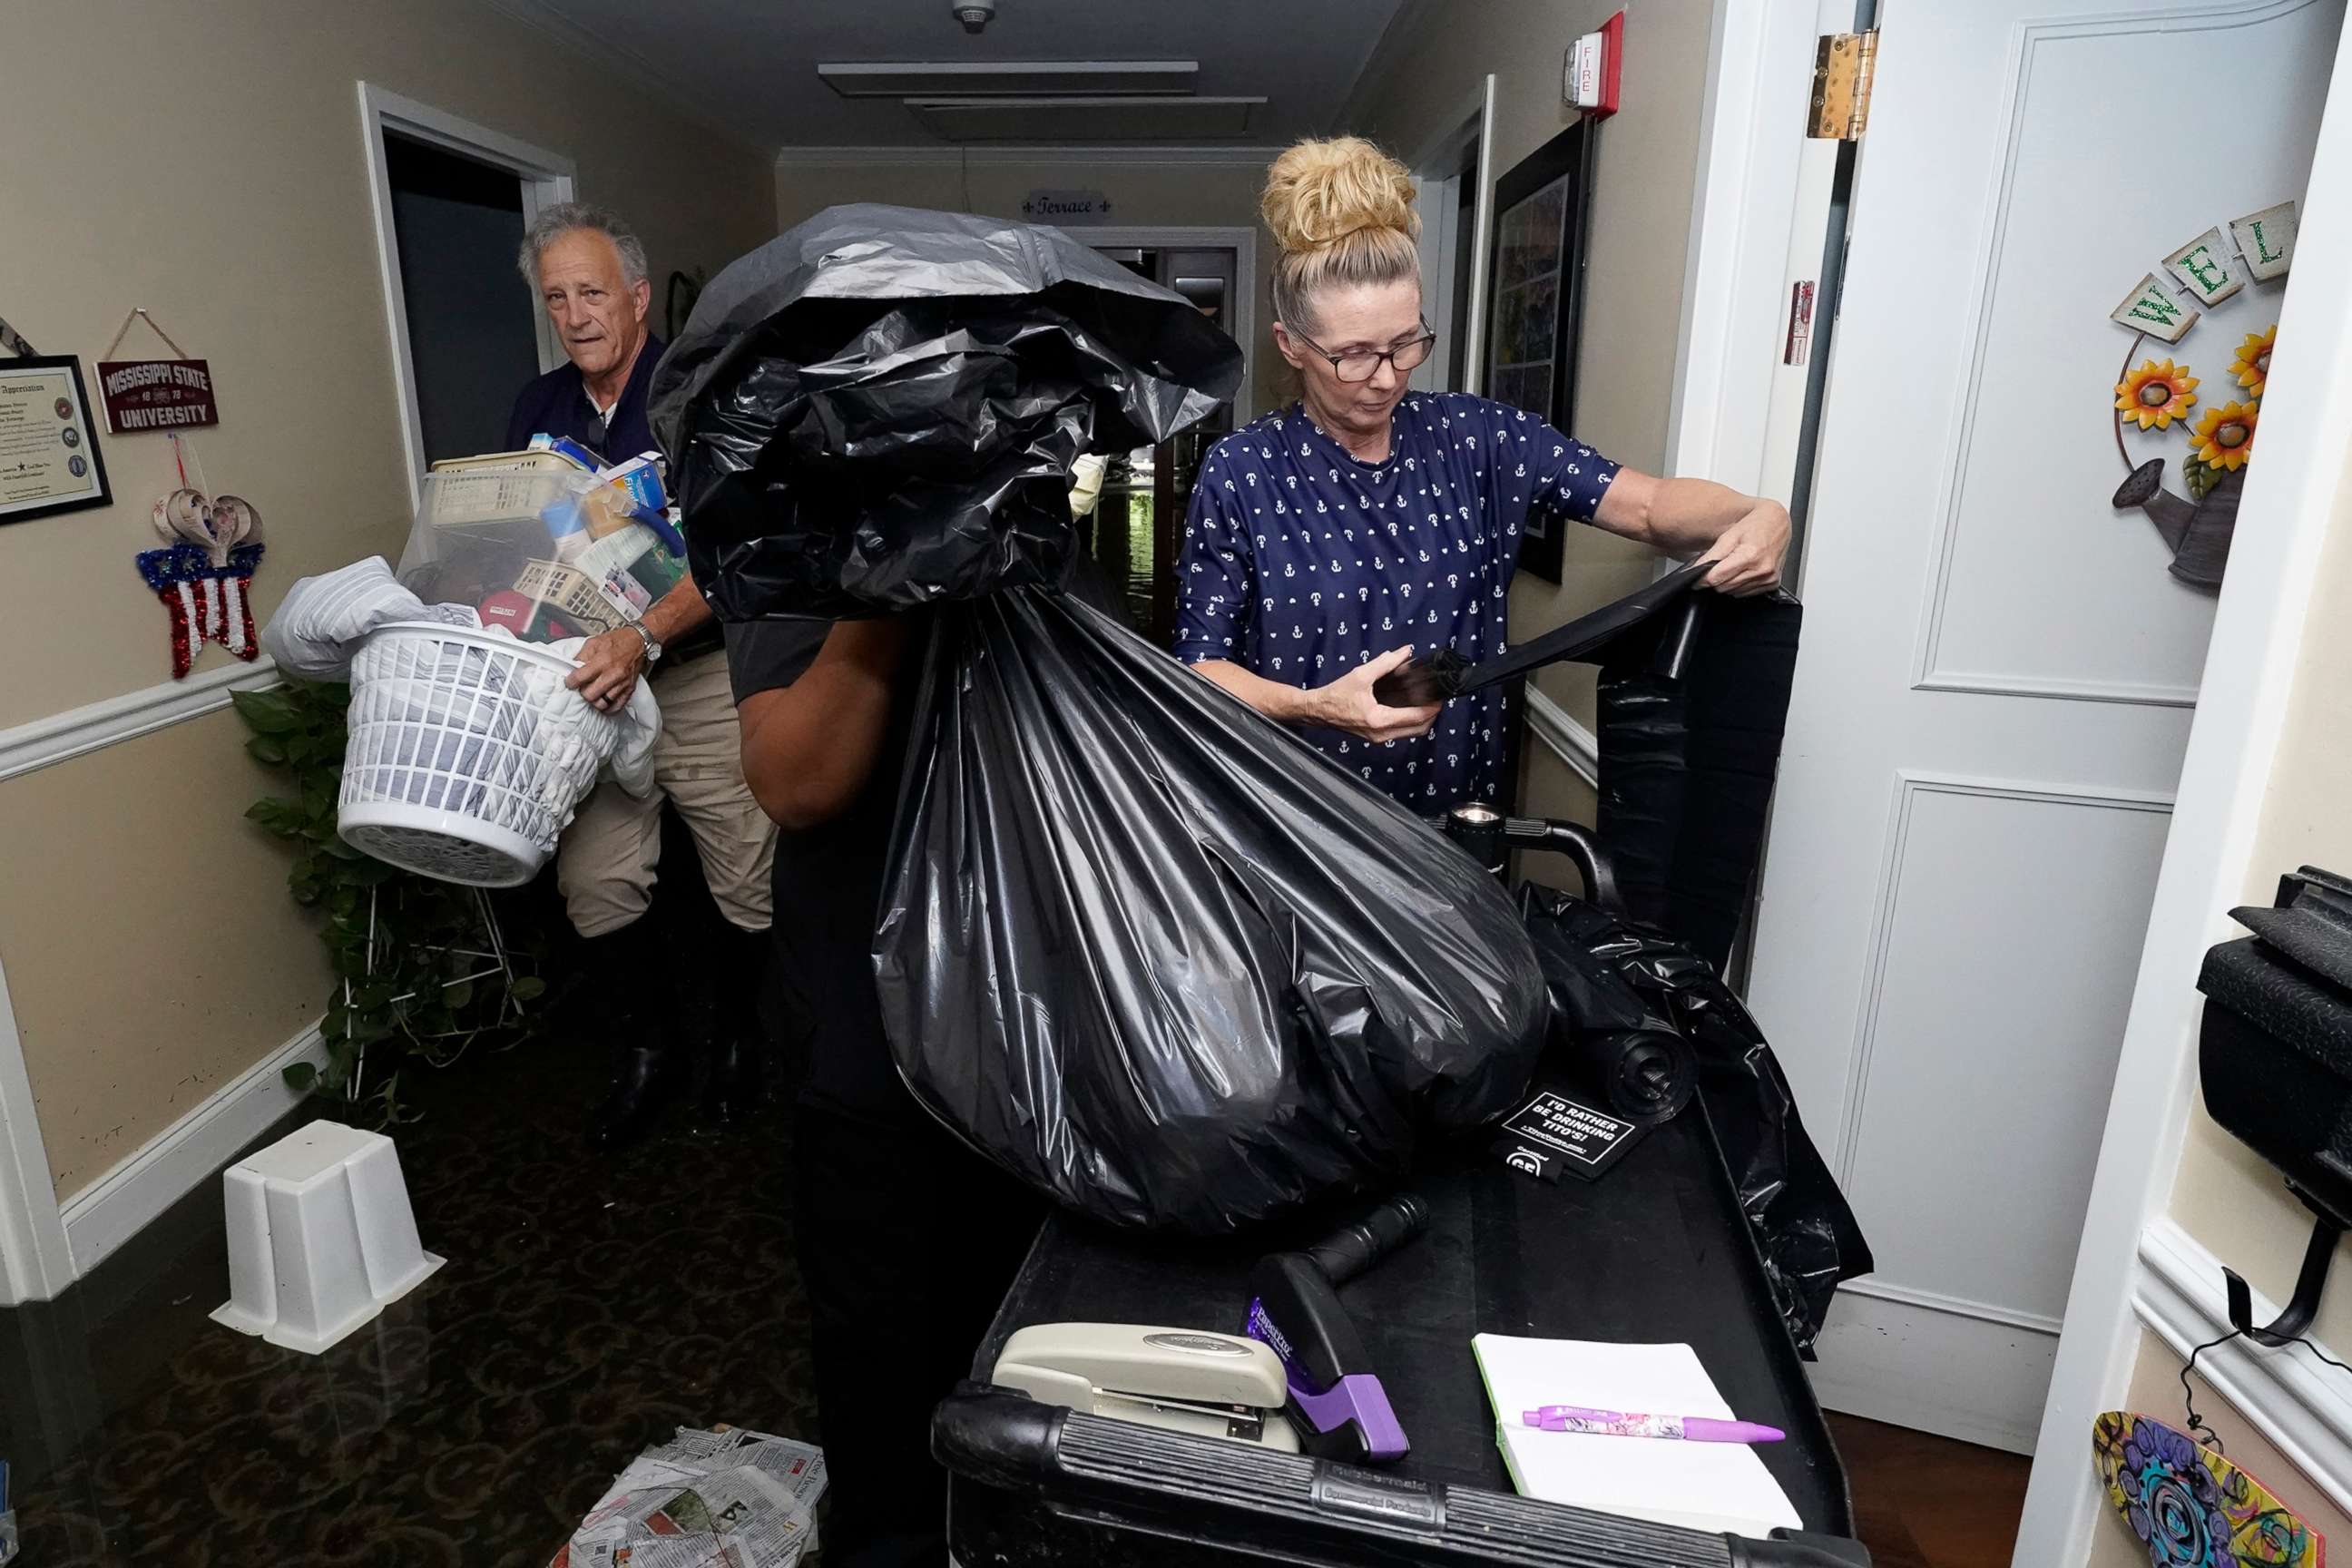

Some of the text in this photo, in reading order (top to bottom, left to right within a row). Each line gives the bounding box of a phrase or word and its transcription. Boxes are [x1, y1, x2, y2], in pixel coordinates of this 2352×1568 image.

[1582, 46, 1592, 92] FIRE
[1037, 196, 1092, 215] Terrace
[105, 363, 210, 397] MISSISSIPPI STATE
[119, 404, 208, 429] UNIVERSITY
[1532, 1103, 1615, 1142] BE DRINKING
[1543, 1119, 1589, 1142] TITO'S!
[1546, 1100, 1619, 1132] I'D RATHER
[1331, 1465, 1429, 1494] Rubbermaid
